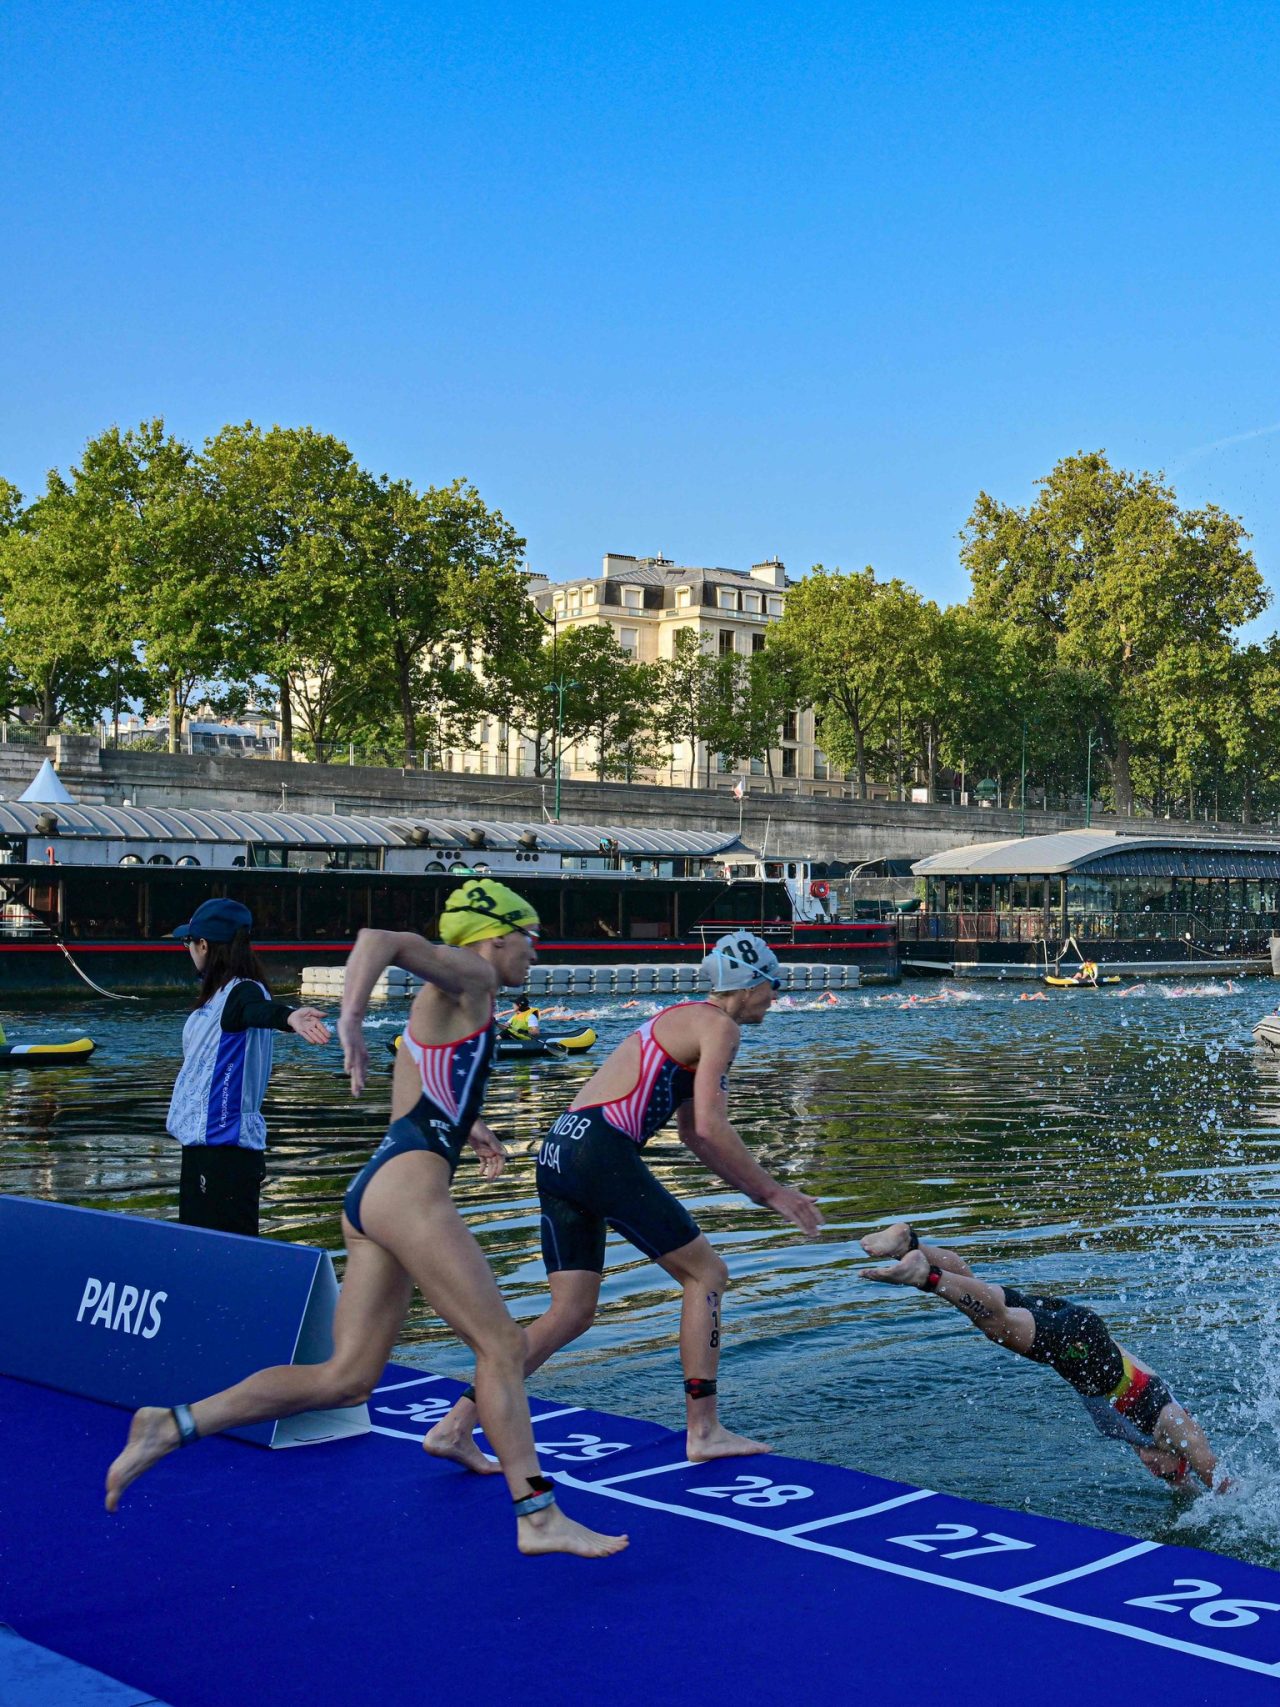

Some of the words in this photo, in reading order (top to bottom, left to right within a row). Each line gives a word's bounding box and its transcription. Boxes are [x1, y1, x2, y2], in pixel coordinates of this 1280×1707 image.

[722, 939, 759, 970] 18
[549, 1113, 592, 1140] NIBB
[539, 1142, 561, 1174] USA
[76, 1277, 168, 1339] PARIS
[375, 1398, 453, 1423] 30
[534, 1433, 632, 1461] 29
[685, 1475, 815, 1508] 28
[885, 1523, 1037, 1560] 27
